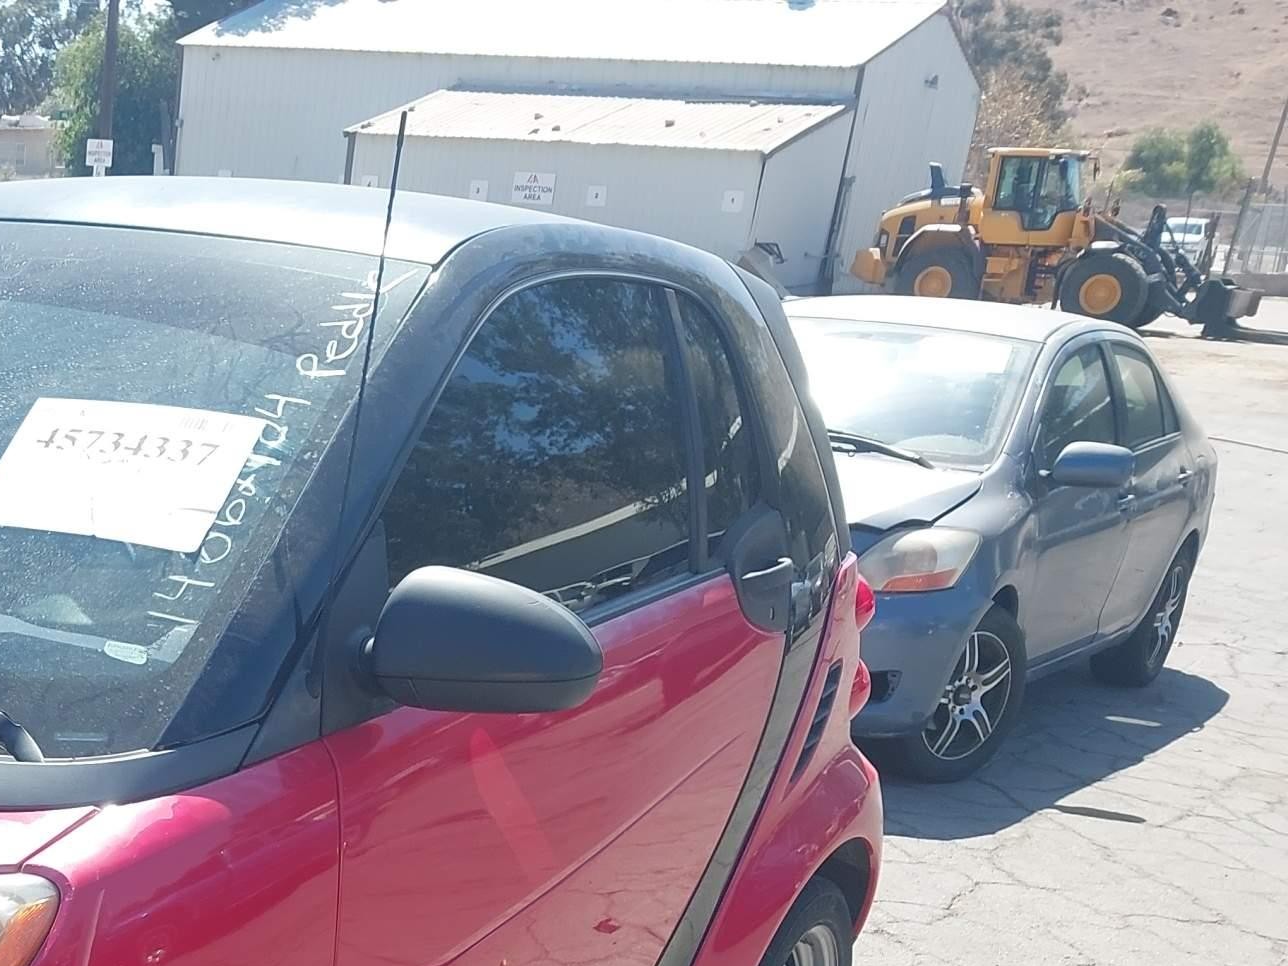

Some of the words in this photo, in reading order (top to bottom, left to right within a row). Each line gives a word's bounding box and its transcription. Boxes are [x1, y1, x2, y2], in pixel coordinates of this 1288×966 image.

[513, 184, 553, 193] INSPECTION
[523, 192, 542, 201] AREA
[36, 427, 220, 466] 45734337
